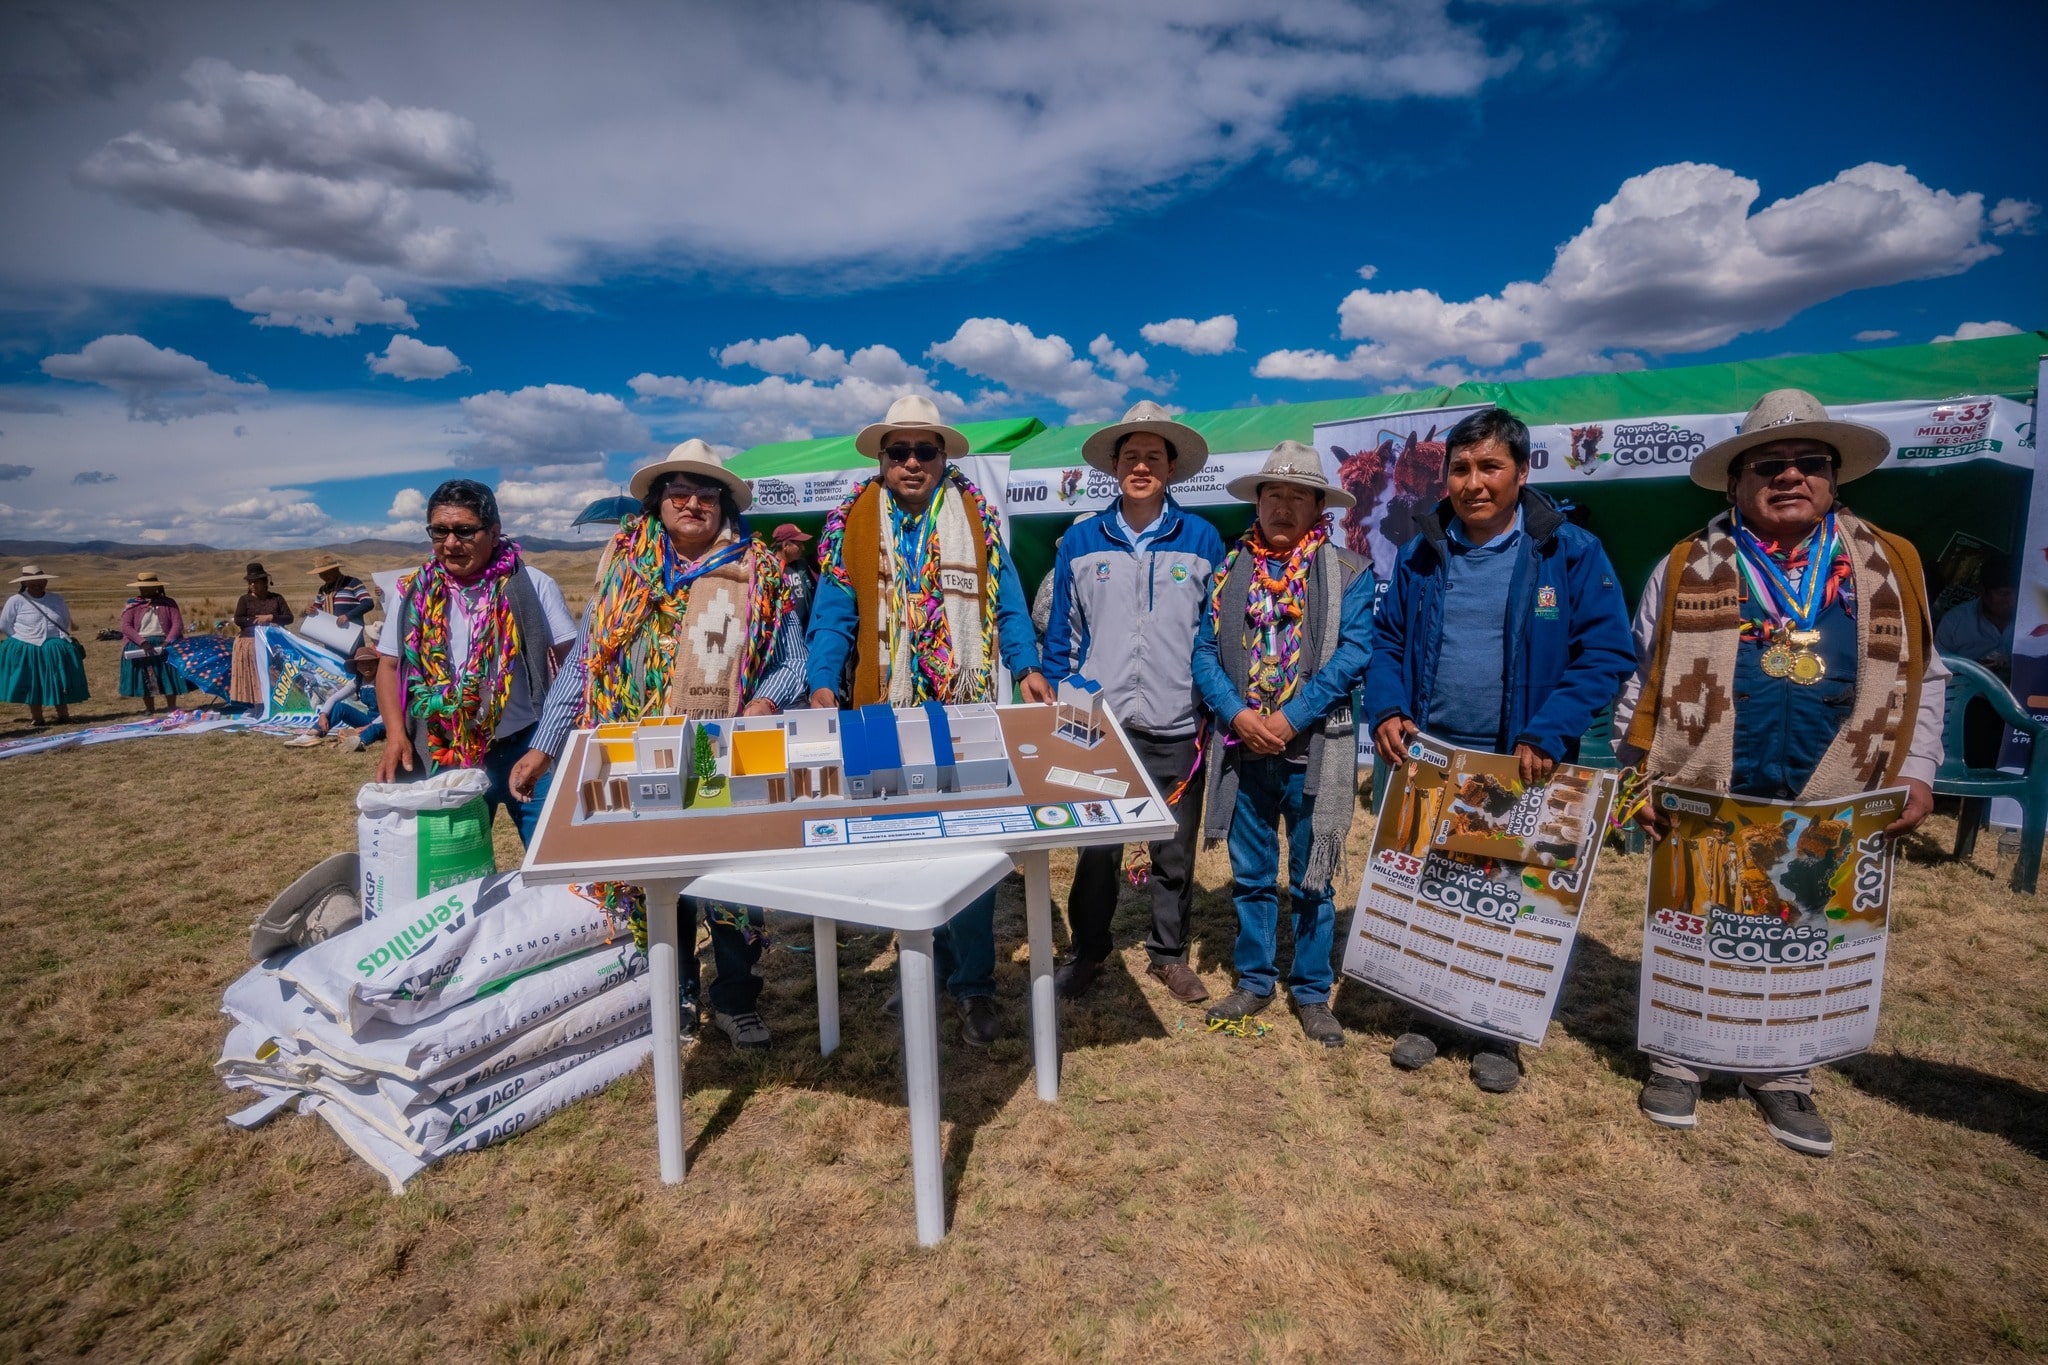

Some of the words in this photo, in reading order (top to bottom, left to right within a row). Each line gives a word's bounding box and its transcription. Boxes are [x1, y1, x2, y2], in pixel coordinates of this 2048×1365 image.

[1616, 424, 1667, 435] Proyecto
[1617, 432, 1690, 446] ALPACAS
[1691, 434, 1703, 442] de
[1918, 422, 1987, 436] MILLONES
[1936, 437, 1950, 445] DE
[1616, 445, 1704, 464] COLOR
[1905, 448, 1933, 458] CUI:
[760, 485, 788, 493] ALPACAS
[760, 493, 796, 505] COLOR
[944, 574, 974, 589] TEXAS
[1422, 752, 1447, 767] PUNO
[1513, 791, 1530, 836] ALPACAS
[1522, 787, 1545, 837] COLOR
[1681, 803, 1710, 815] PUNO
[1864, 799, 1894, 809] GRDA
[1380, 851, 1421, 875] +33
[1428, 852, 1485, 876] Proyecto
[1854, 831, 1885, 911] 2026
[1372, 863, 1416, 885] MILLONES
[1425, 865, 1505, 896] ALPACAS
[1506, 892, 1519, 901] de
[365, 871, 376, 909] AGP
[376, 875, 384, 912] semillas
[1397, 881, 1414, 891] SOLES
[1422, 880, 1518, 923] COLOR
[1523, 914, 1538, 922] CUI:
[1540, 917, 1573, 929] 2557255.
[1658, 911, 1705, 935] +33
[1712, 908, 1782, 924] Proyecto
[357, 895, 464, 978] semillas
[1651, 925, 1703, 946] MILLONES
[1711, 921, 1811, 941] ALPACAS
[1813, 929, 1826, 938] de
[481, 932, 560, 965] SABEMOS
[1681, 942, 1703, 951] SOLES
[1711, 938, 1828, 962] COLOR
[1833, 942, 1851, 951] CUI:
[1852, 934, 1884, 947] 2557255.
[432, 956, 462, 979] AGP
[428, 974, 464, 991] emillas
[521, 986, 588, 1025] SABEMOS
[431, 1024, 512, 1062] SEMBRAR
[480, 1054, 517, 1080] AGP
[490, 1077, 526, 1111] AGP
[490, 1112, 527, 1144] AGP
